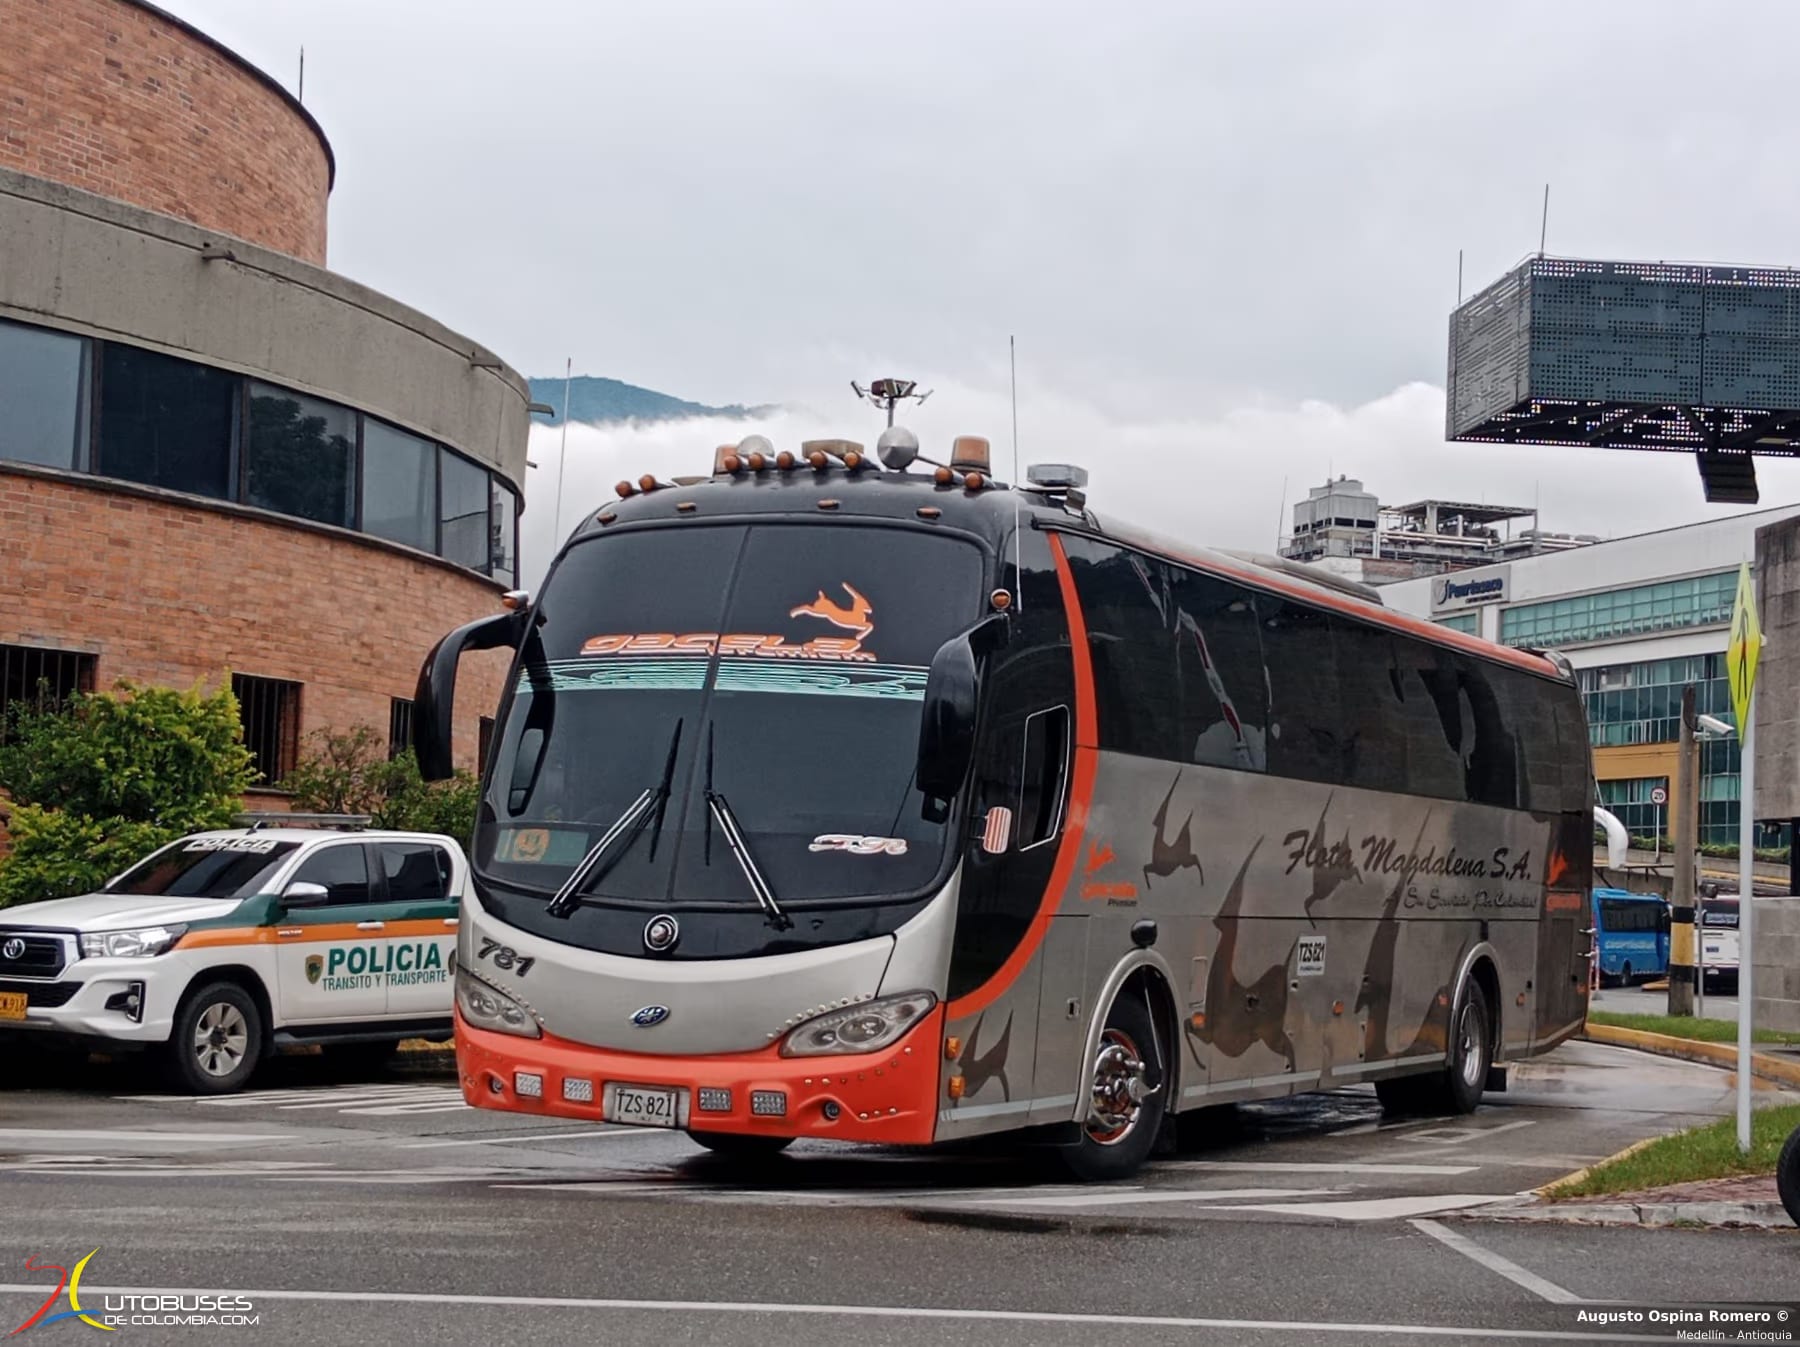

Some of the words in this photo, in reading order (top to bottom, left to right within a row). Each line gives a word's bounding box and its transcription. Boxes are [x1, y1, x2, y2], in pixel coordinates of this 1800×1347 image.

[1361, 835, 1486, 885] Magdalena
[1490, 847, 1532, 881] S.A.
[328, 943, 442, 976] POLICIA
[478, 936, 536, 978] 781
[322, 975, 372, 992] TRANSITO
[375, 974, 382, 987] Y
[385, 969, 447, 987] TRANSPORTE
